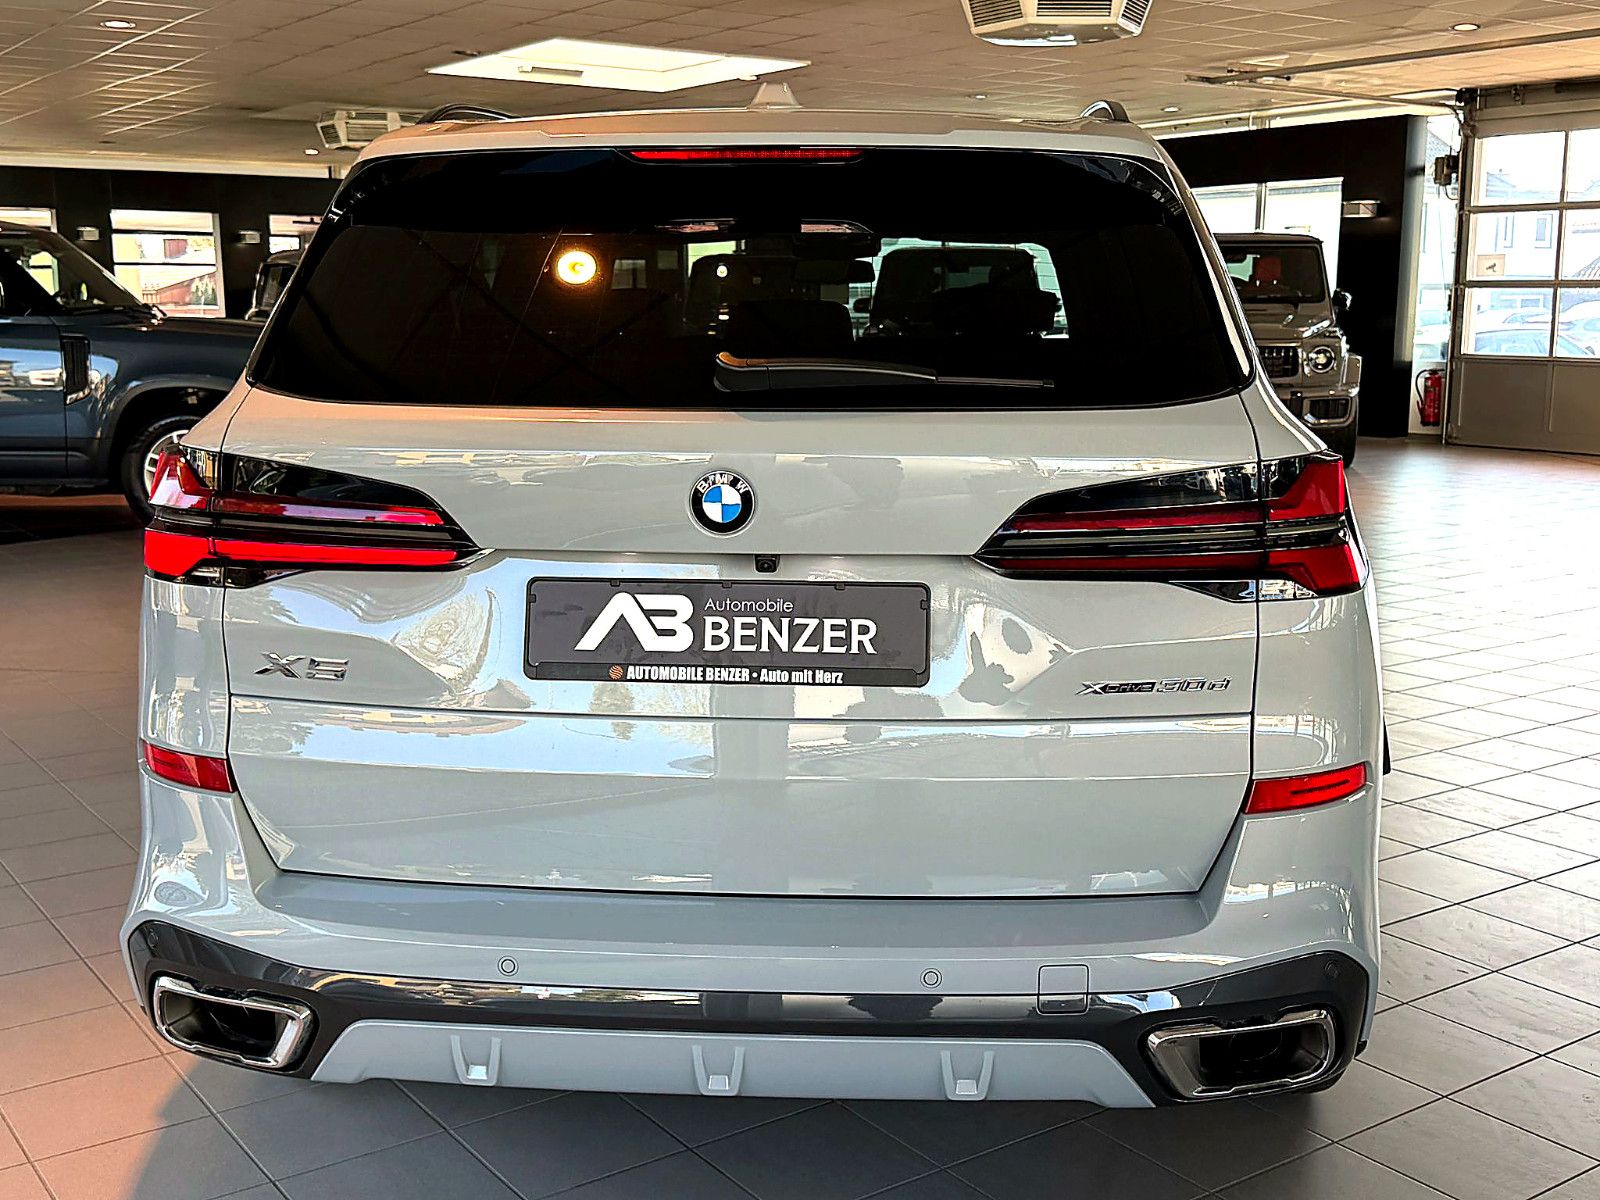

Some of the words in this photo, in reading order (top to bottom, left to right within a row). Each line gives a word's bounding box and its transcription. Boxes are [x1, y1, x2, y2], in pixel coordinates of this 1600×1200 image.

[697, 473, 749, 494] BMW
[704, 597, 794, 613] Automobile
[702, 616, 878, 654] BENZER
[253, 652, 349, 681] X5
[626, 665, 704, 681] AUTOMOBILE
[705, 666, 750, 682] BENZER
[759, 669, 789, 683] Auto
[791, 669, 813, 683] mit
[814, 669, 844, 684] Herz
